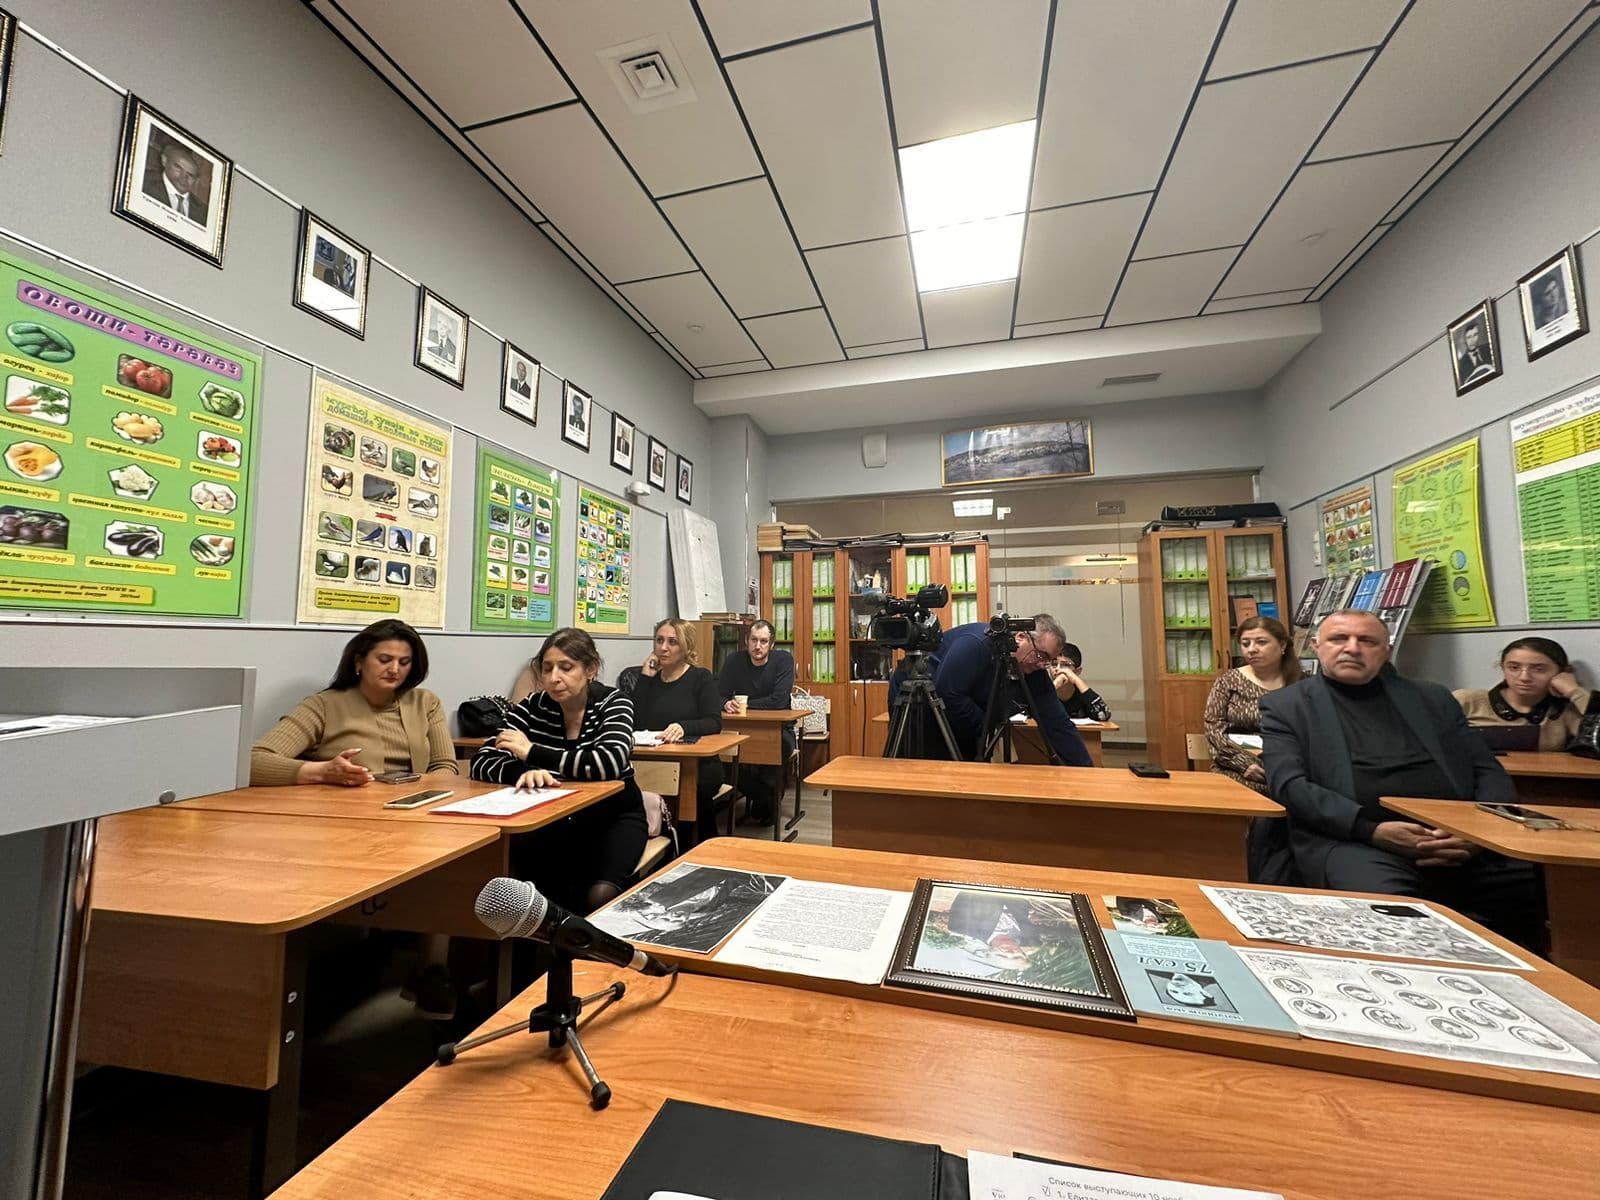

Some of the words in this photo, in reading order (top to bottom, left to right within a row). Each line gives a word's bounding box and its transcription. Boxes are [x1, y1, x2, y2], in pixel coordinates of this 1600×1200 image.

[1185, 962, 1213, 975] 75
[1048, 1177, 1081, 1188] Список
[1084, 1184, 1146, 1199] выступающих
